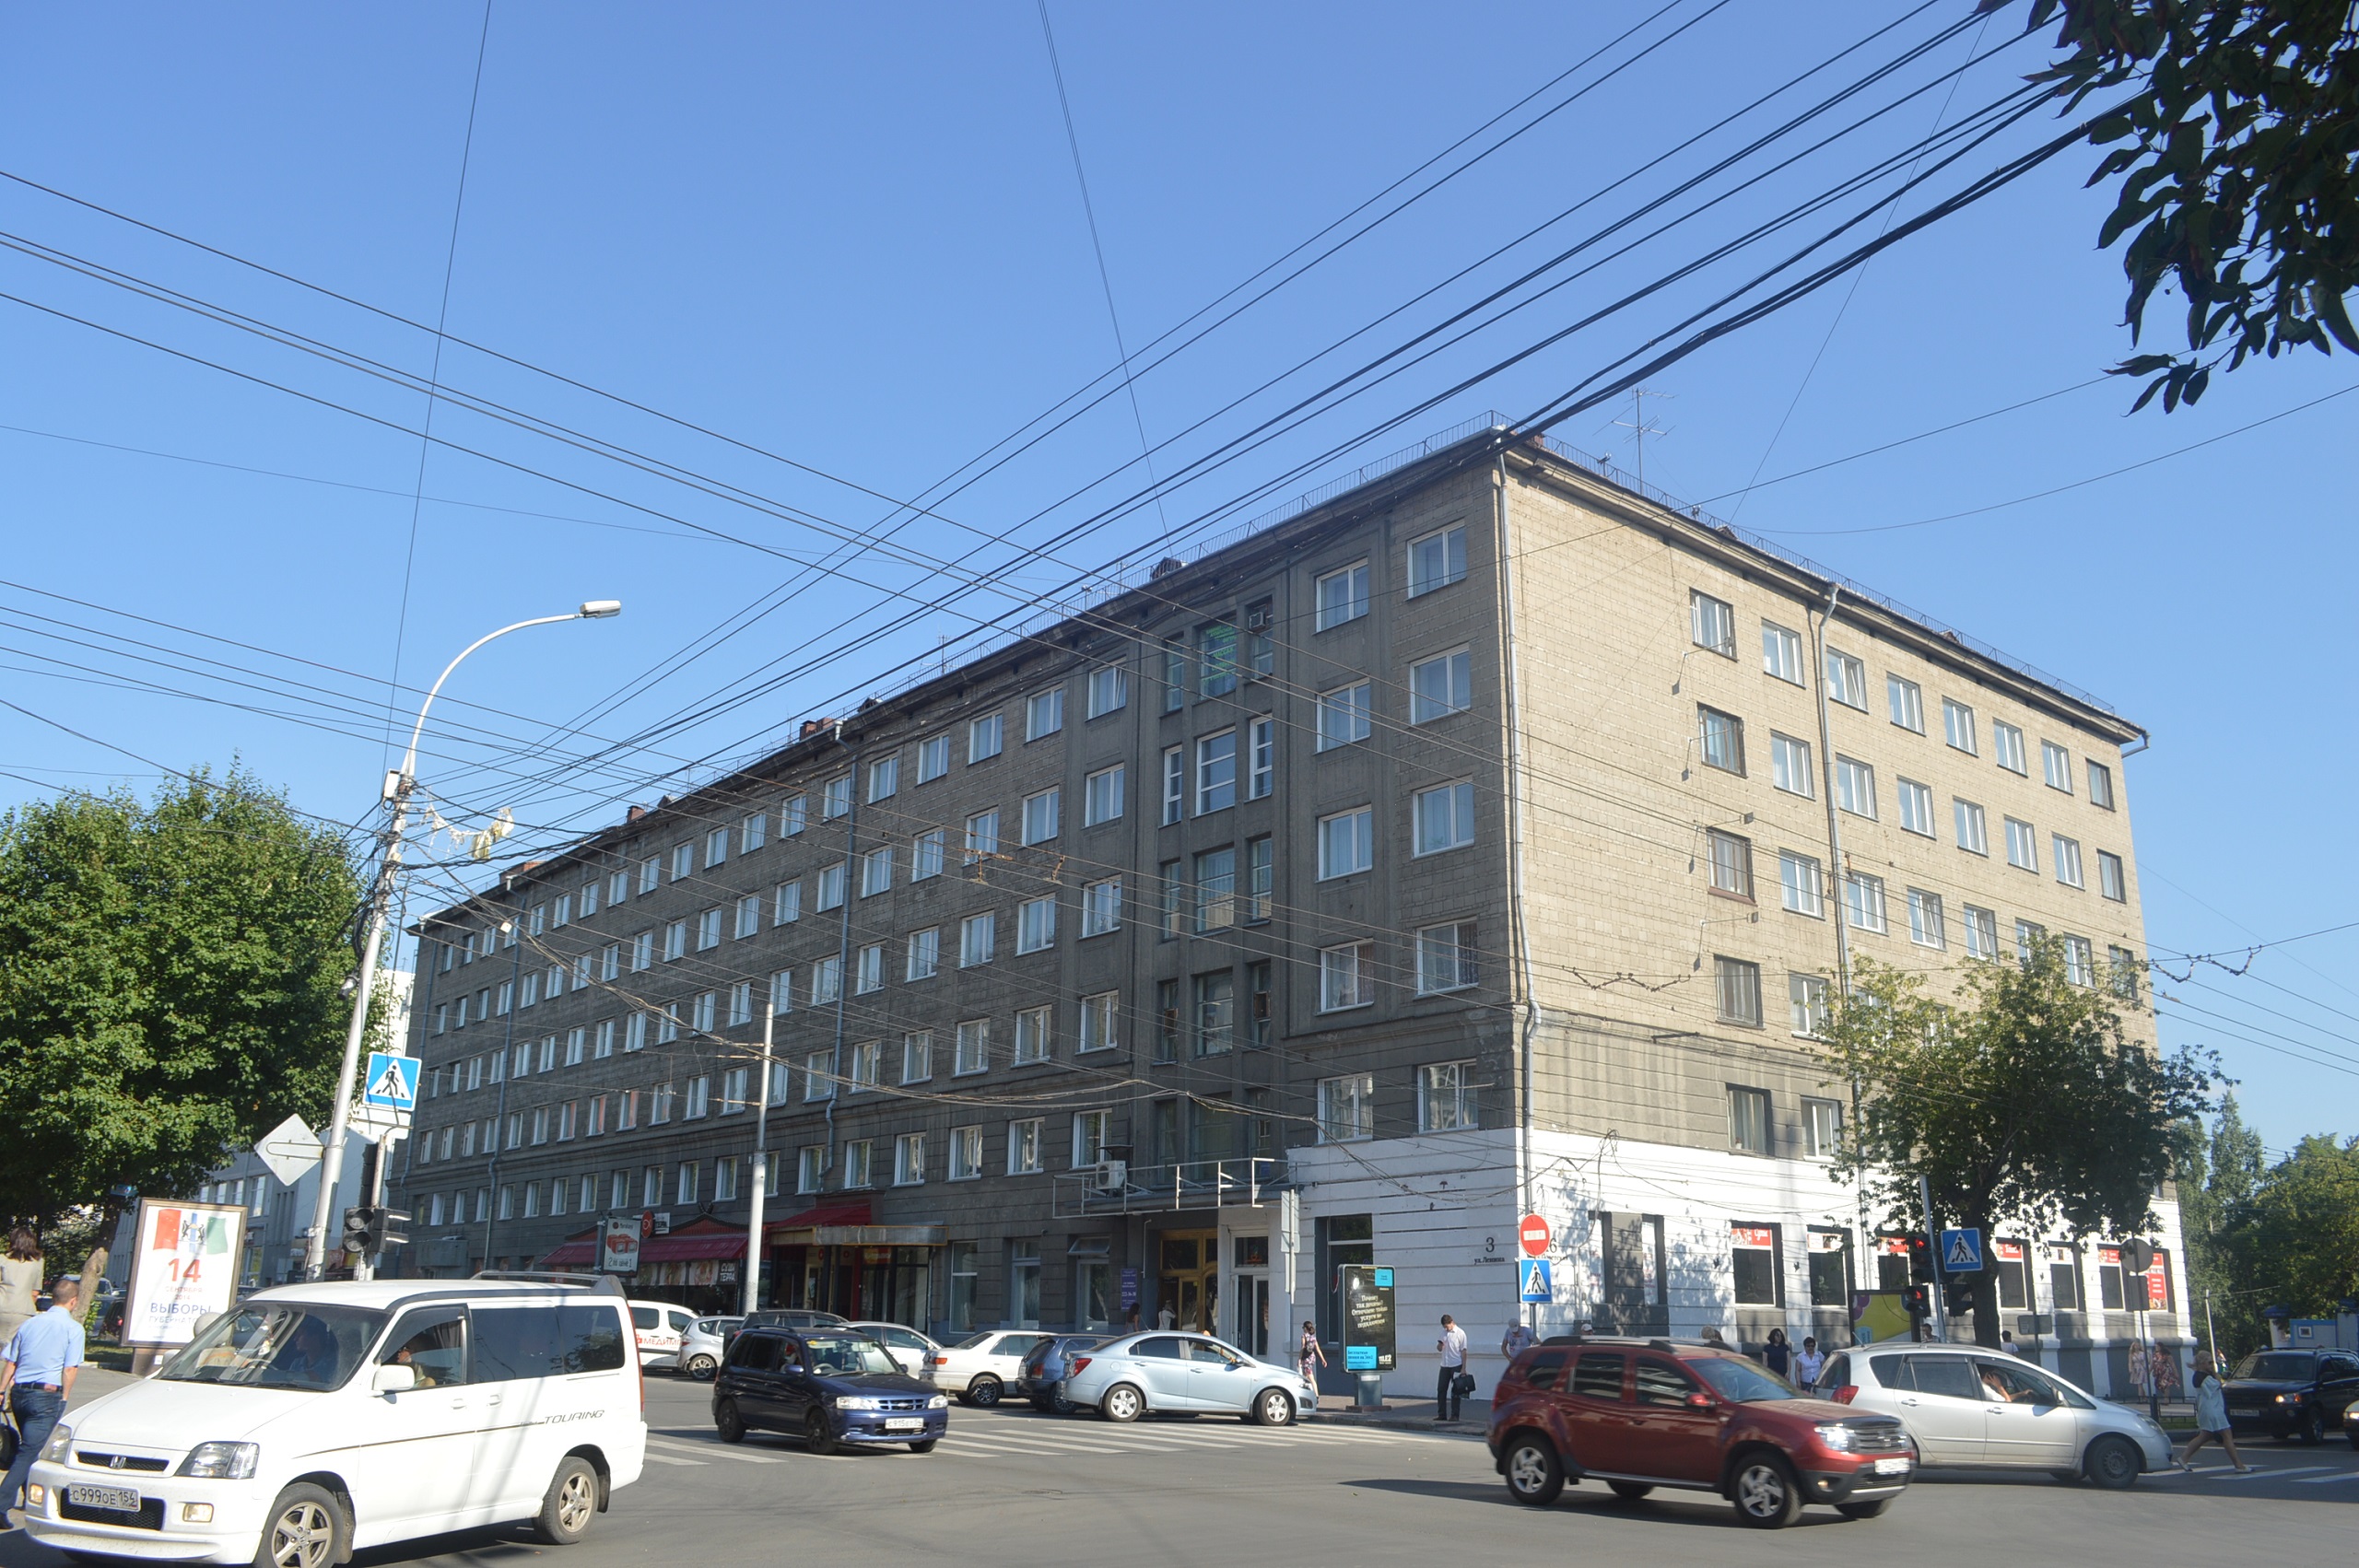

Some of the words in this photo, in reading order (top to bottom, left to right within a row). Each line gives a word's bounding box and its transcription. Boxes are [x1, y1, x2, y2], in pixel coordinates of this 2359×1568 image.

[1485, 1236, 1495, 1253] 3
[168, 1258, 201, 1282] 14
[150, 1302, 211, 1316] ВЫБОРЫ
[545, 1410, 604, 1424] TOURING
